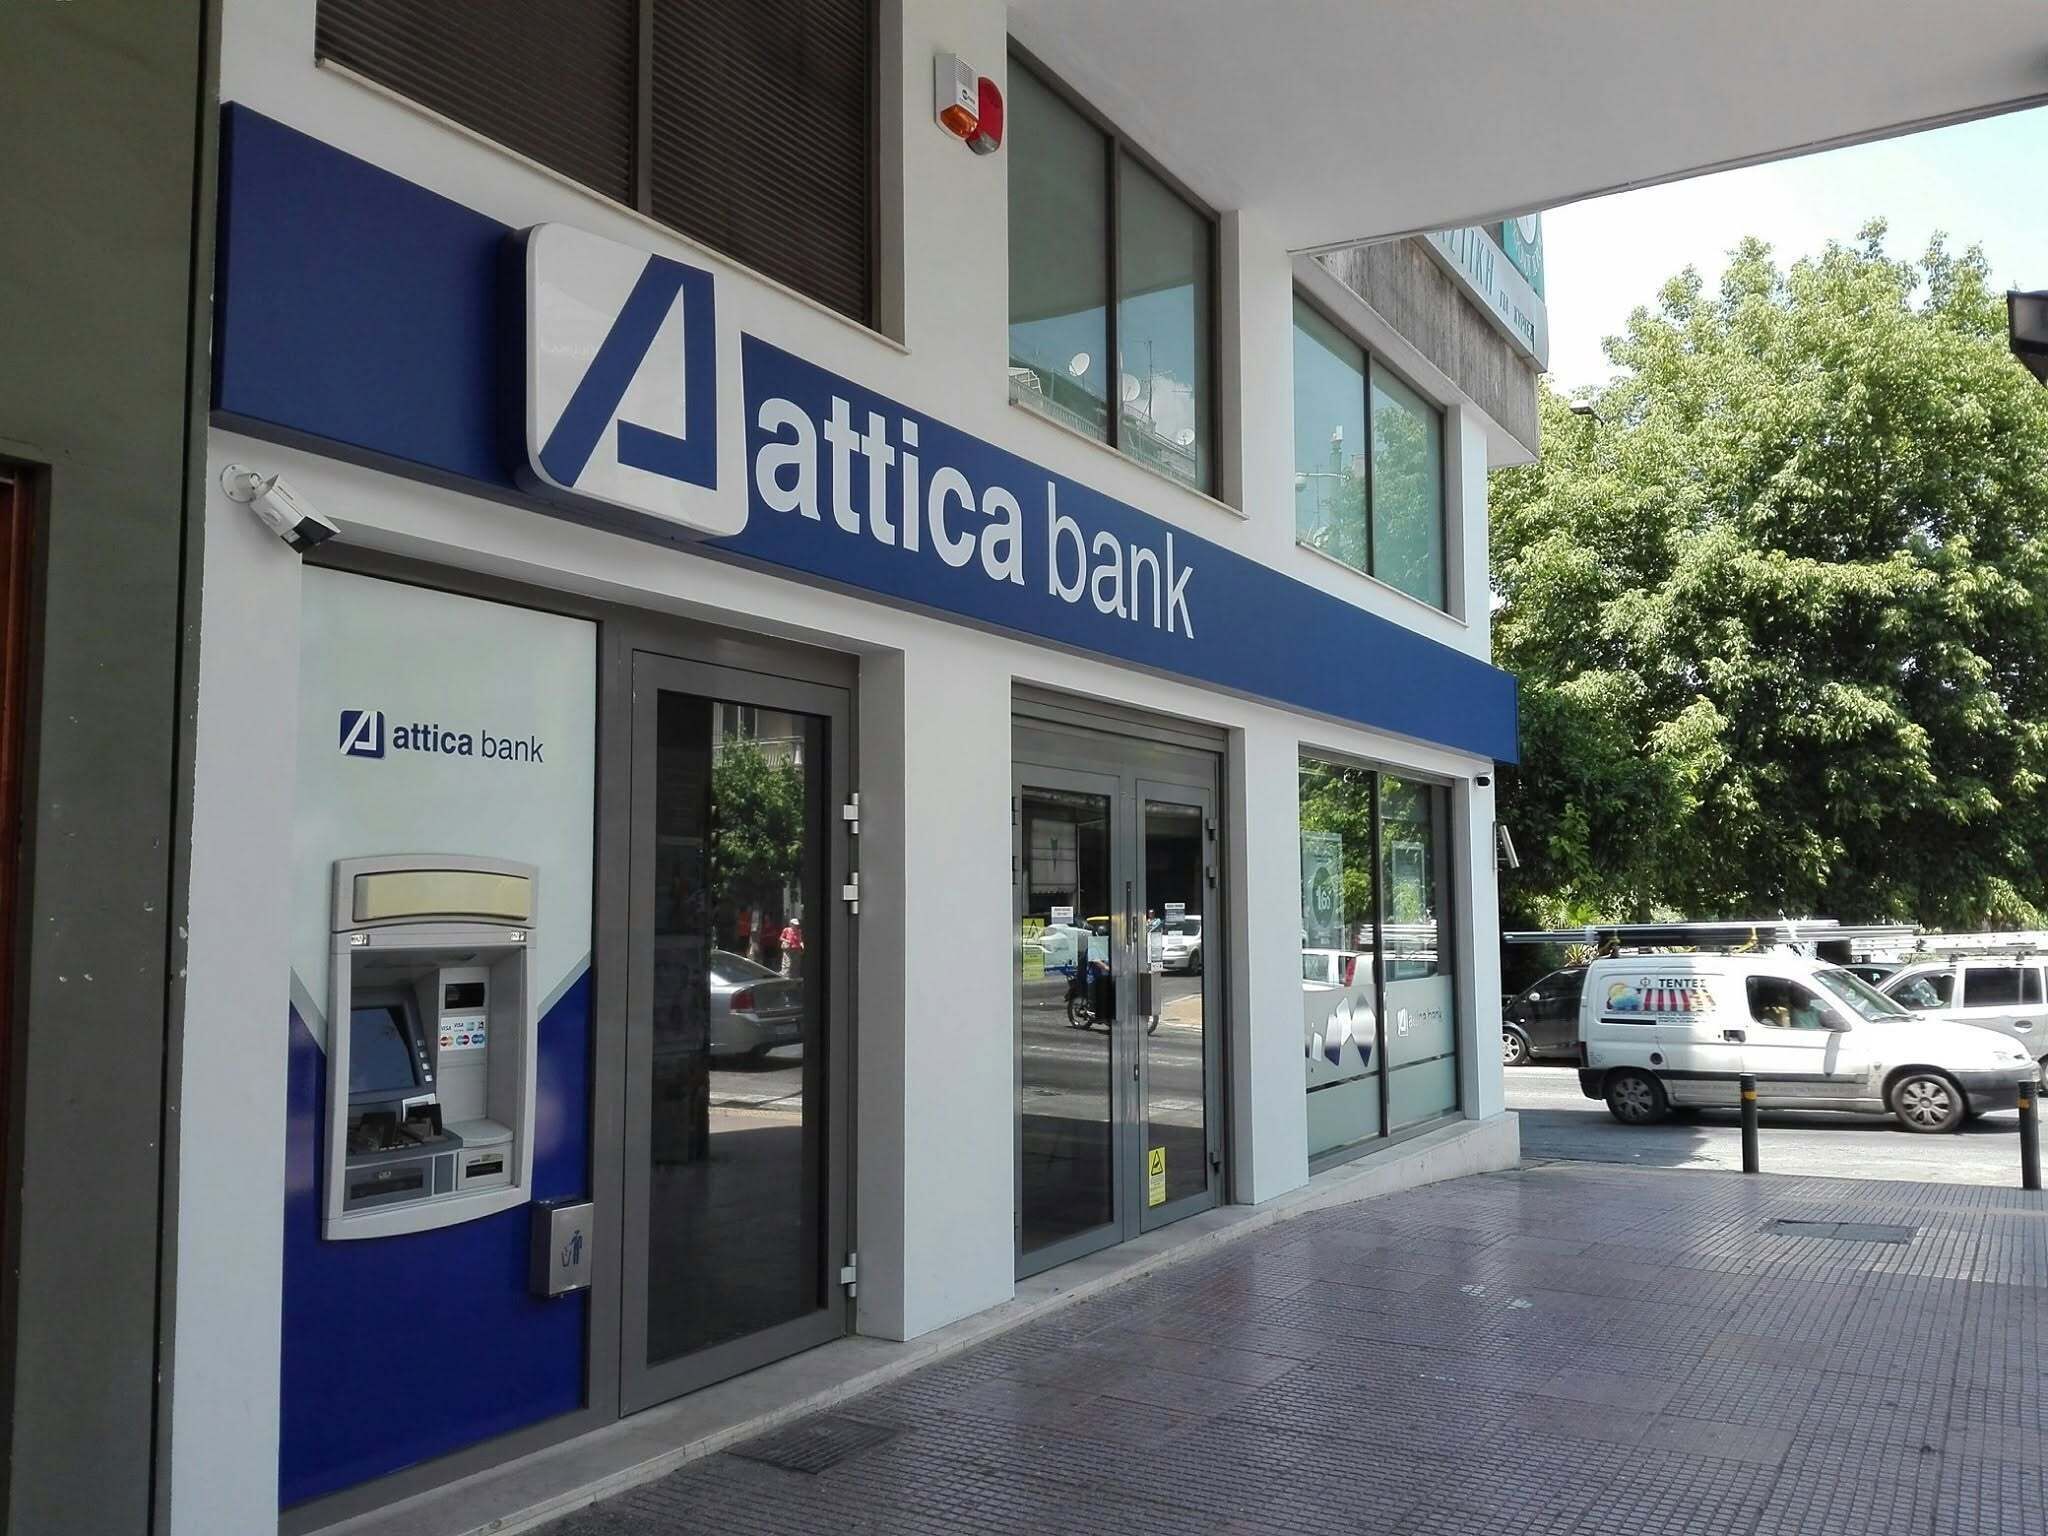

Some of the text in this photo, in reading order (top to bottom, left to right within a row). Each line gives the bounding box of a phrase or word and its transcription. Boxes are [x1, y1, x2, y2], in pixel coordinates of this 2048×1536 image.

[755, 395, 1025, 586] attica
[1048, 481, 1194, 639] bank
[393, 723, 473, 756] attica
[482, 730, 544, 763] bank
